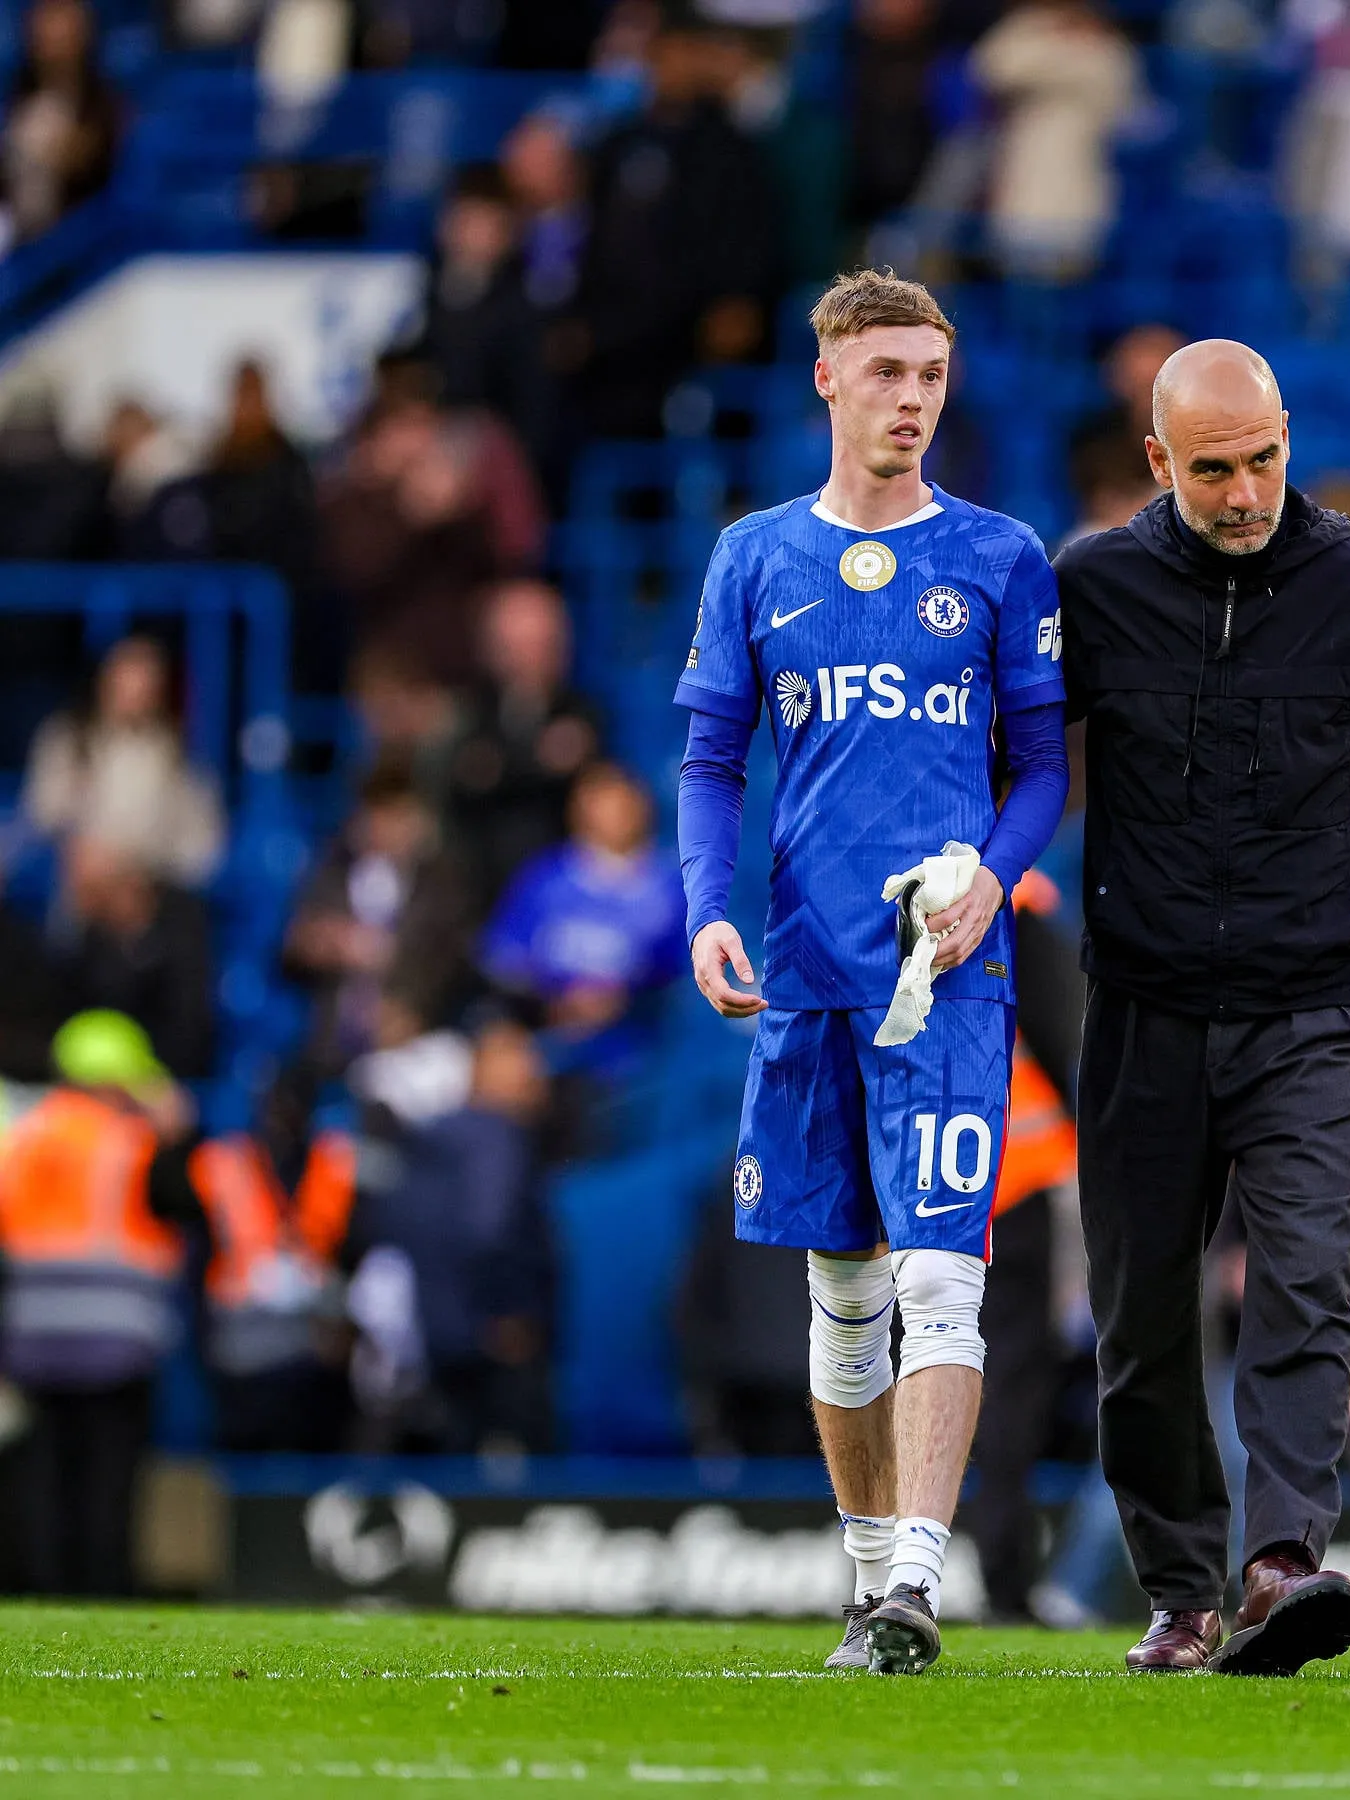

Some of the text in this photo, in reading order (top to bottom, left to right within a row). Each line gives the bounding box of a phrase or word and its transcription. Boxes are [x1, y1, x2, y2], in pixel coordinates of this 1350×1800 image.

[844, 545, 892, 572] WORLD CHAMPIONS
[857, 578, 879, 587] FIFA
[926, 588, 961, 602] CHELSEA
[817, 663, 973, 726] IFS.ai
[914, 1113, 992, 1194] 10
